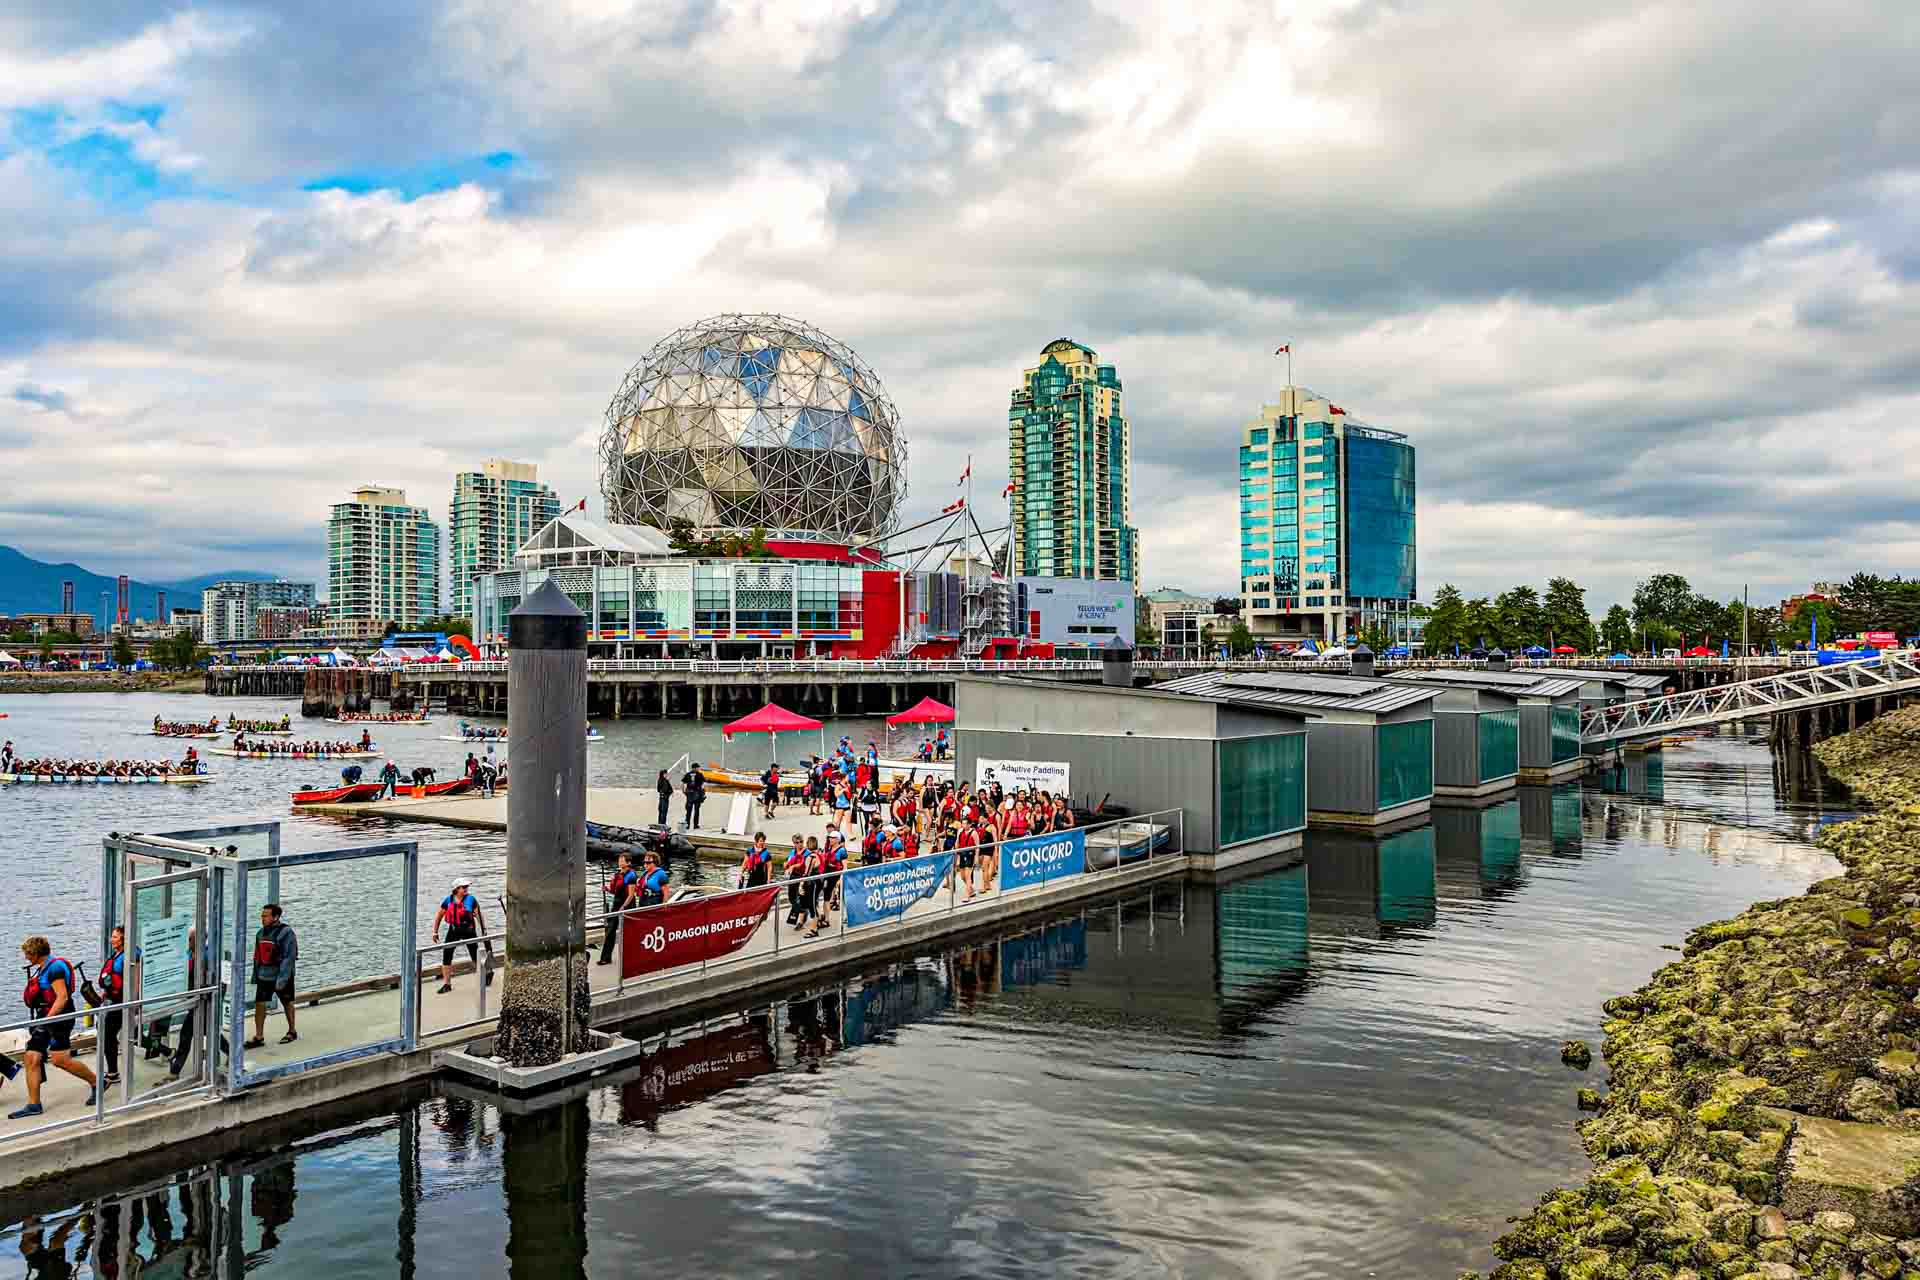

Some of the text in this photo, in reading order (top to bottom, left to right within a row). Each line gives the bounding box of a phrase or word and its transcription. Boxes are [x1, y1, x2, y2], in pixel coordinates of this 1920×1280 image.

[1001, 764, 1065, 777] Adaptive Paddling
[907, 864, 936, 879] PACIFIC
[1023, 863, 1062, 877] PACIFIC
[883, 877, 934, 896] DRAGON BOAT
[668, 925, 709, 942] DRAGON
[711, 919, 734, 933] BOAT
[735, 917, 747, 928] BC
